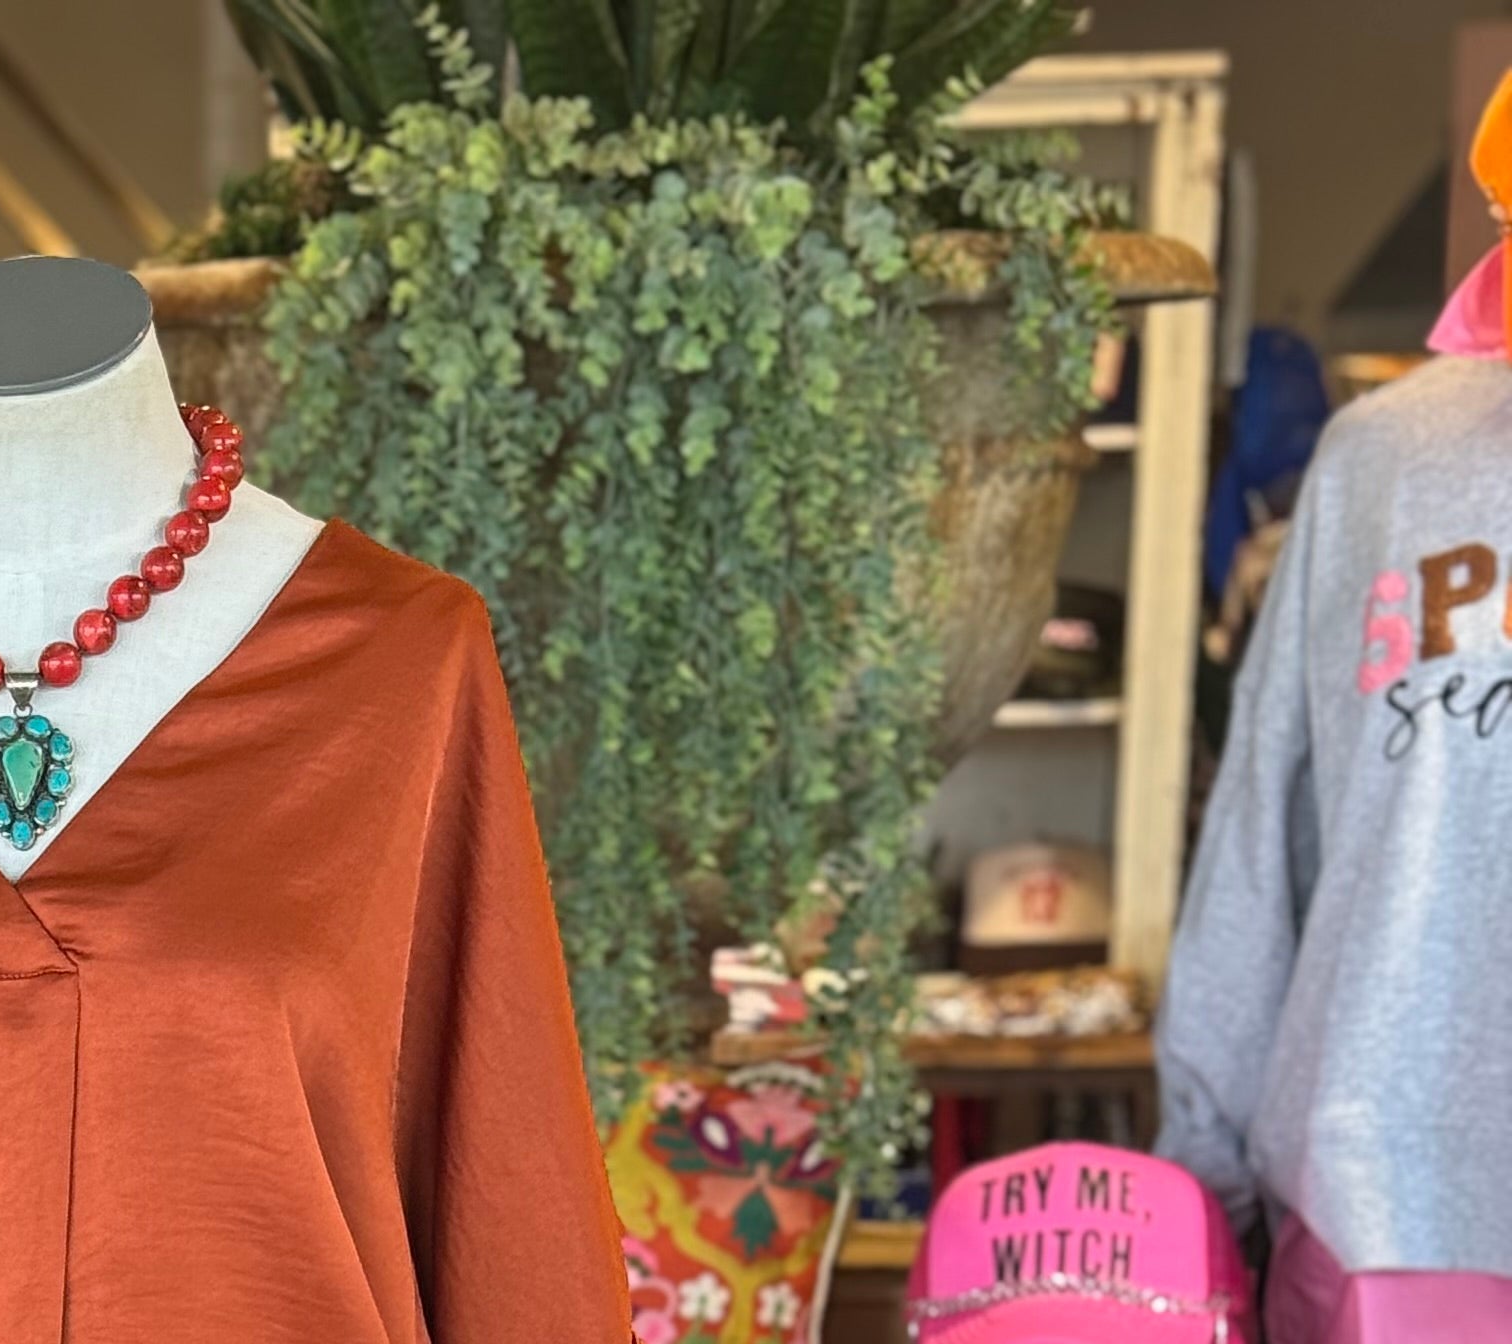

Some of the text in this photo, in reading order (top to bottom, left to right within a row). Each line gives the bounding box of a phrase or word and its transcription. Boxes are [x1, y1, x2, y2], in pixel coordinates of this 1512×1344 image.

[978, 1163, 1152, 1226] TRY ME,
[991, 1229, 1134, 1284] WITCH
